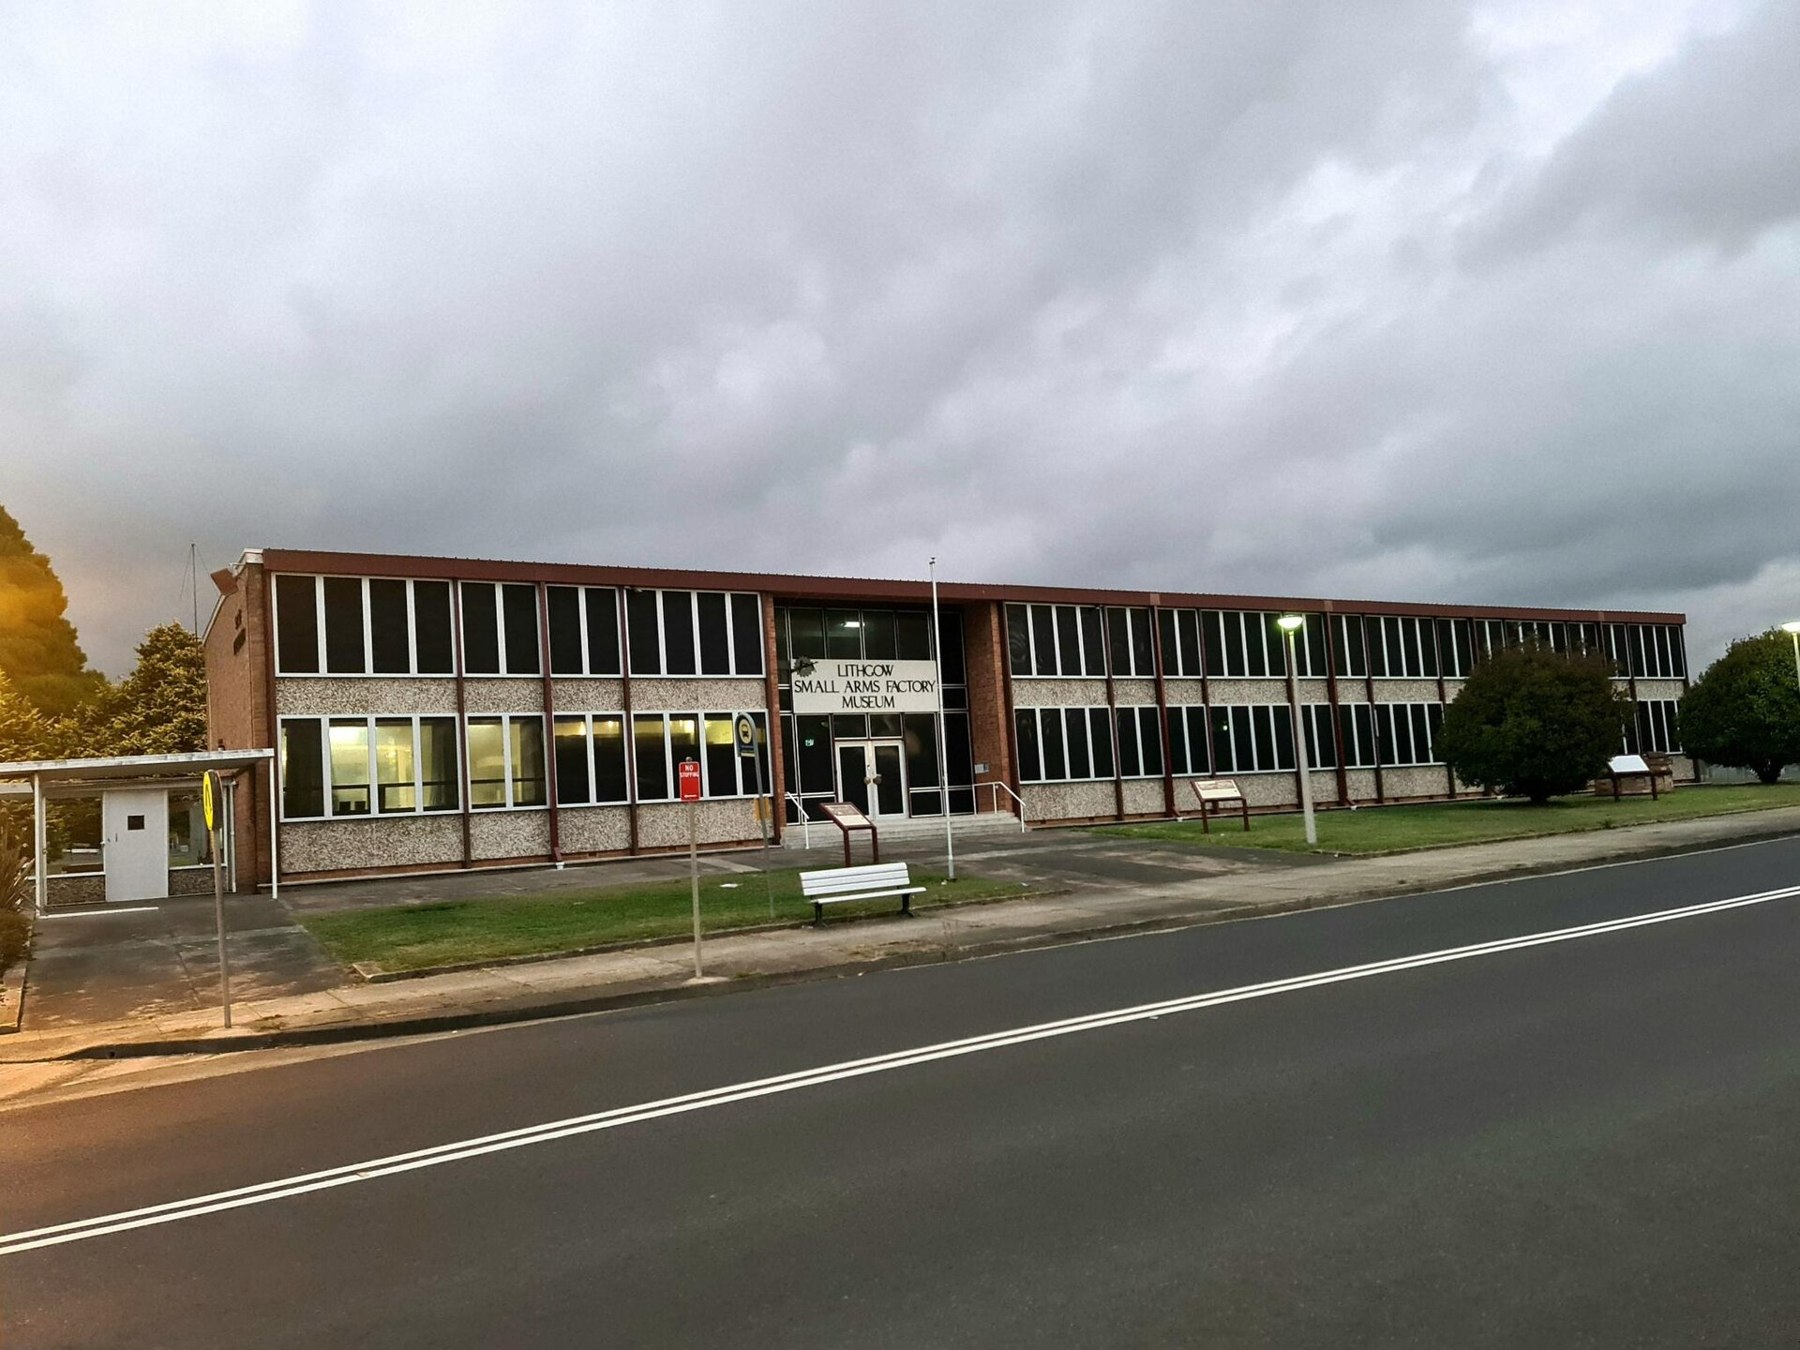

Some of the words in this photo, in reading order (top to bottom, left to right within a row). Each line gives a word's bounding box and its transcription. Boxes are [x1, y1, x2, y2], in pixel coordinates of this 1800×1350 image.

[837, 664, 894, 677] LITHGOW
[794, 680, 840, 693] SMALL
[844, 680, 880, 693] ARMS
[886, 680, 936, 693] FACTORY
[842, 695, 896, 709] MUSEUM
[684, 764, 694, 772] NO
